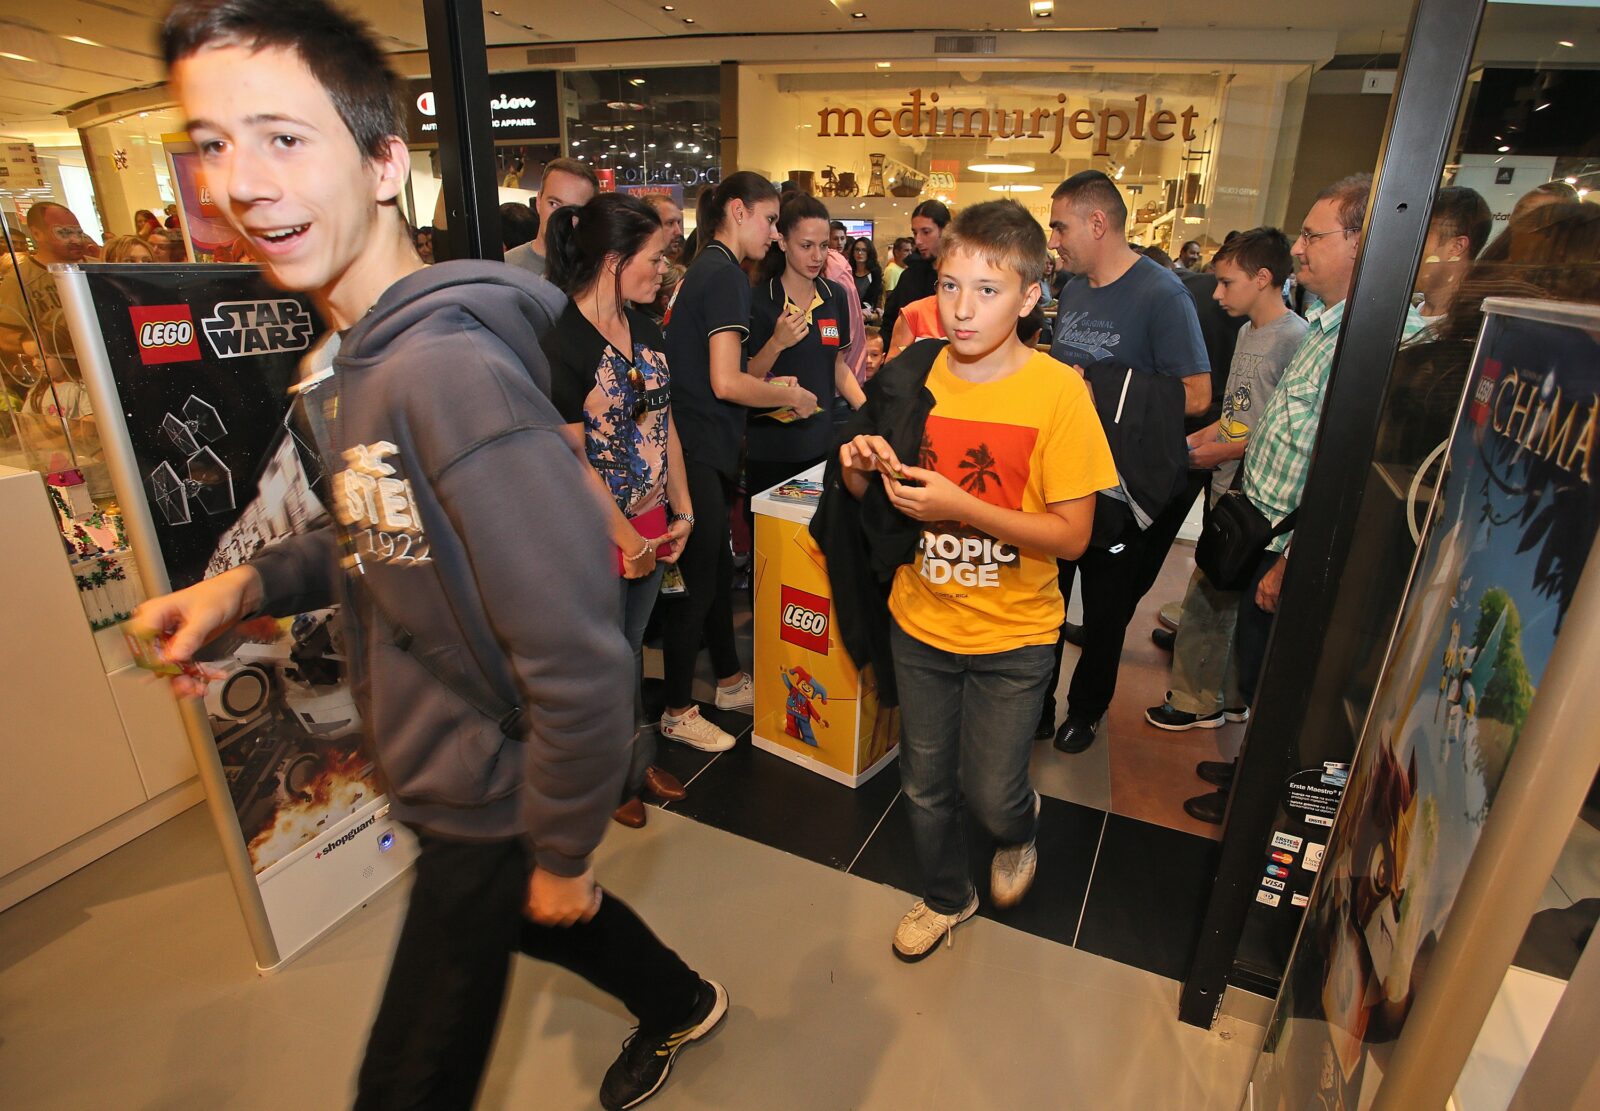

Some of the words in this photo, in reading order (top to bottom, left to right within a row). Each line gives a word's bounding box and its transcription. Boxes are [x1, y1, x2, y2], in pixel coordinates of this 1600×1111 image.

[490, 94, 536, 119] pion
[501, 118, 536, 127] APPAREL
[205, 302, 309, 329] STAR
[141, 321, 192, 346] LEGO
[207, 324, 311, 355] WARS
[1058, 311, 1121, 352] Vintage
[1493, 366, 1600, 484] CHIMA
[919, 530, 1017, 564] ROPIC
[784, 604, 827, 636] LEGO
[1290, 782, 1306, 791] Erste
[322, 815, 376, 856] shopguard
[1265, 879, 1283, 889] VISA
